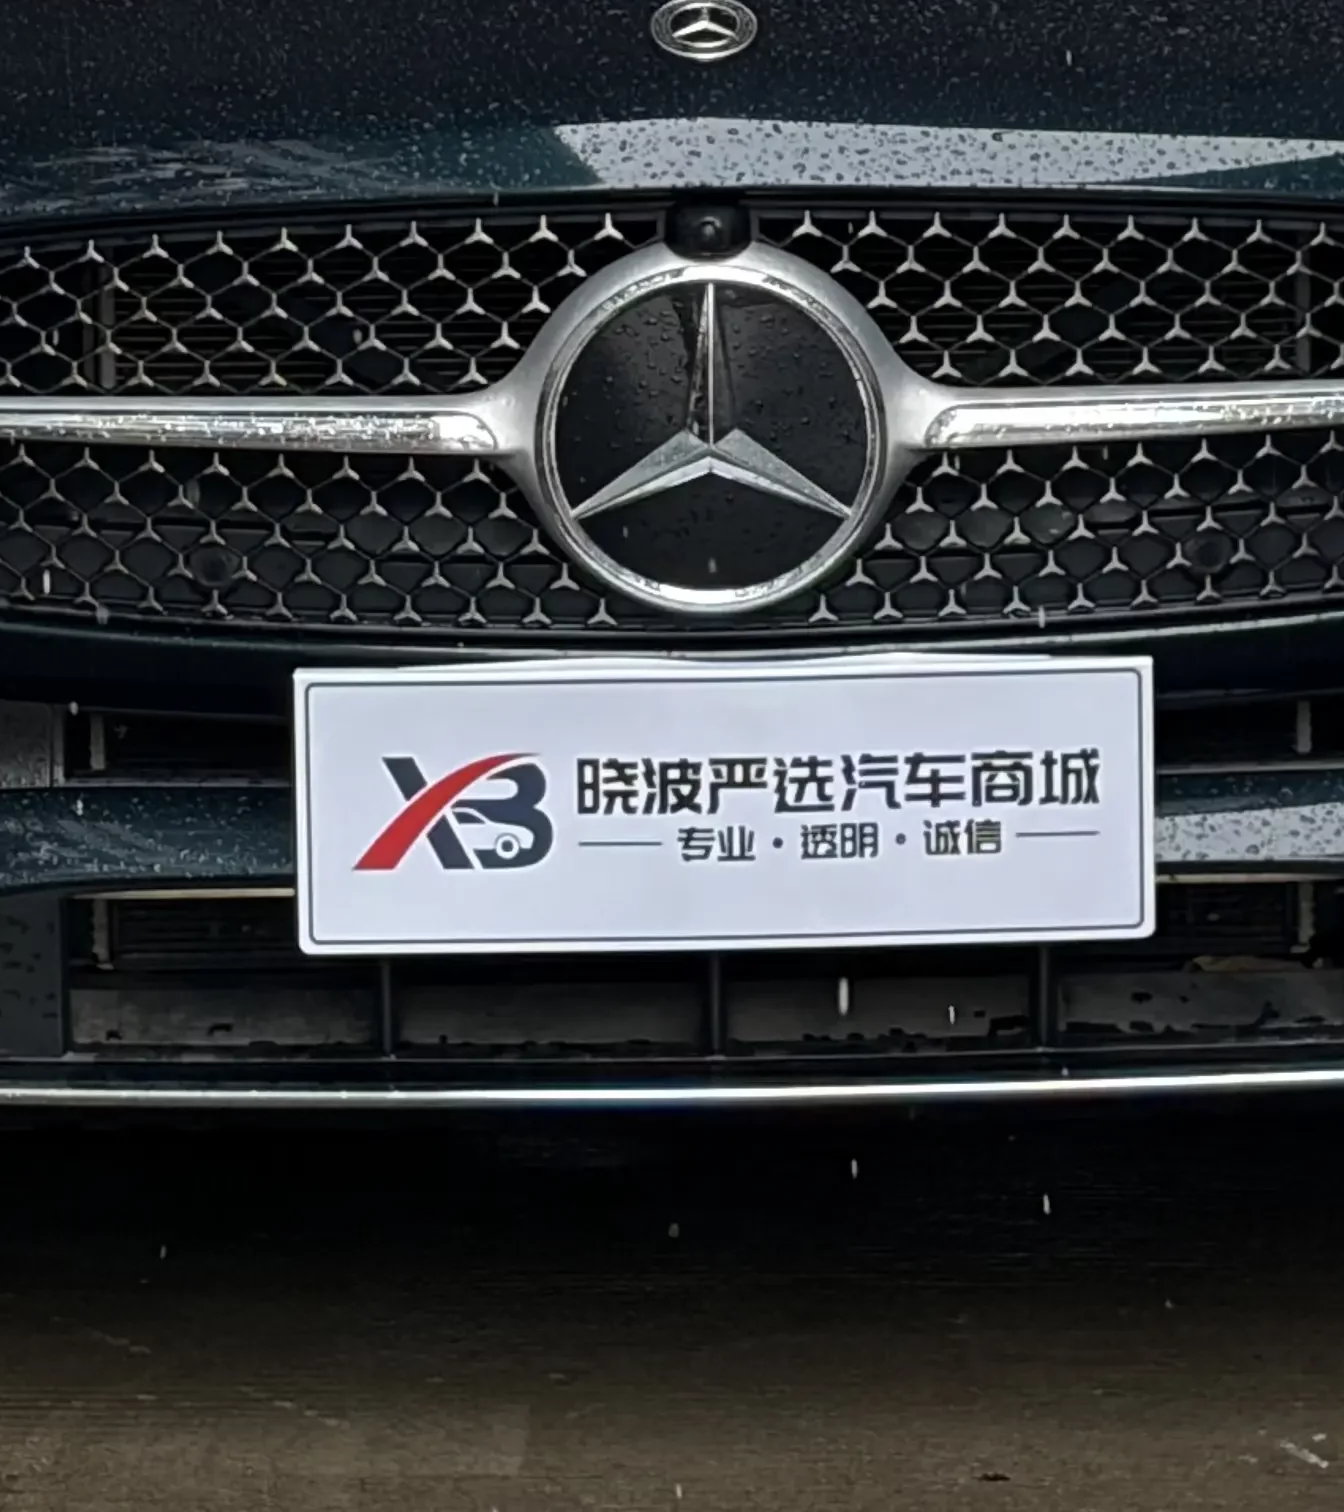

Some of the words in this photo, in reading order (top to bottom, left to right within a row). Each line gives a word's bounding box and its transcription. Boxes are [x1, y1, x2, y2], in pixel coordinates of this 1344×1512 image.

[576, 748, 1100, 815] 晓波严选汽车商城
